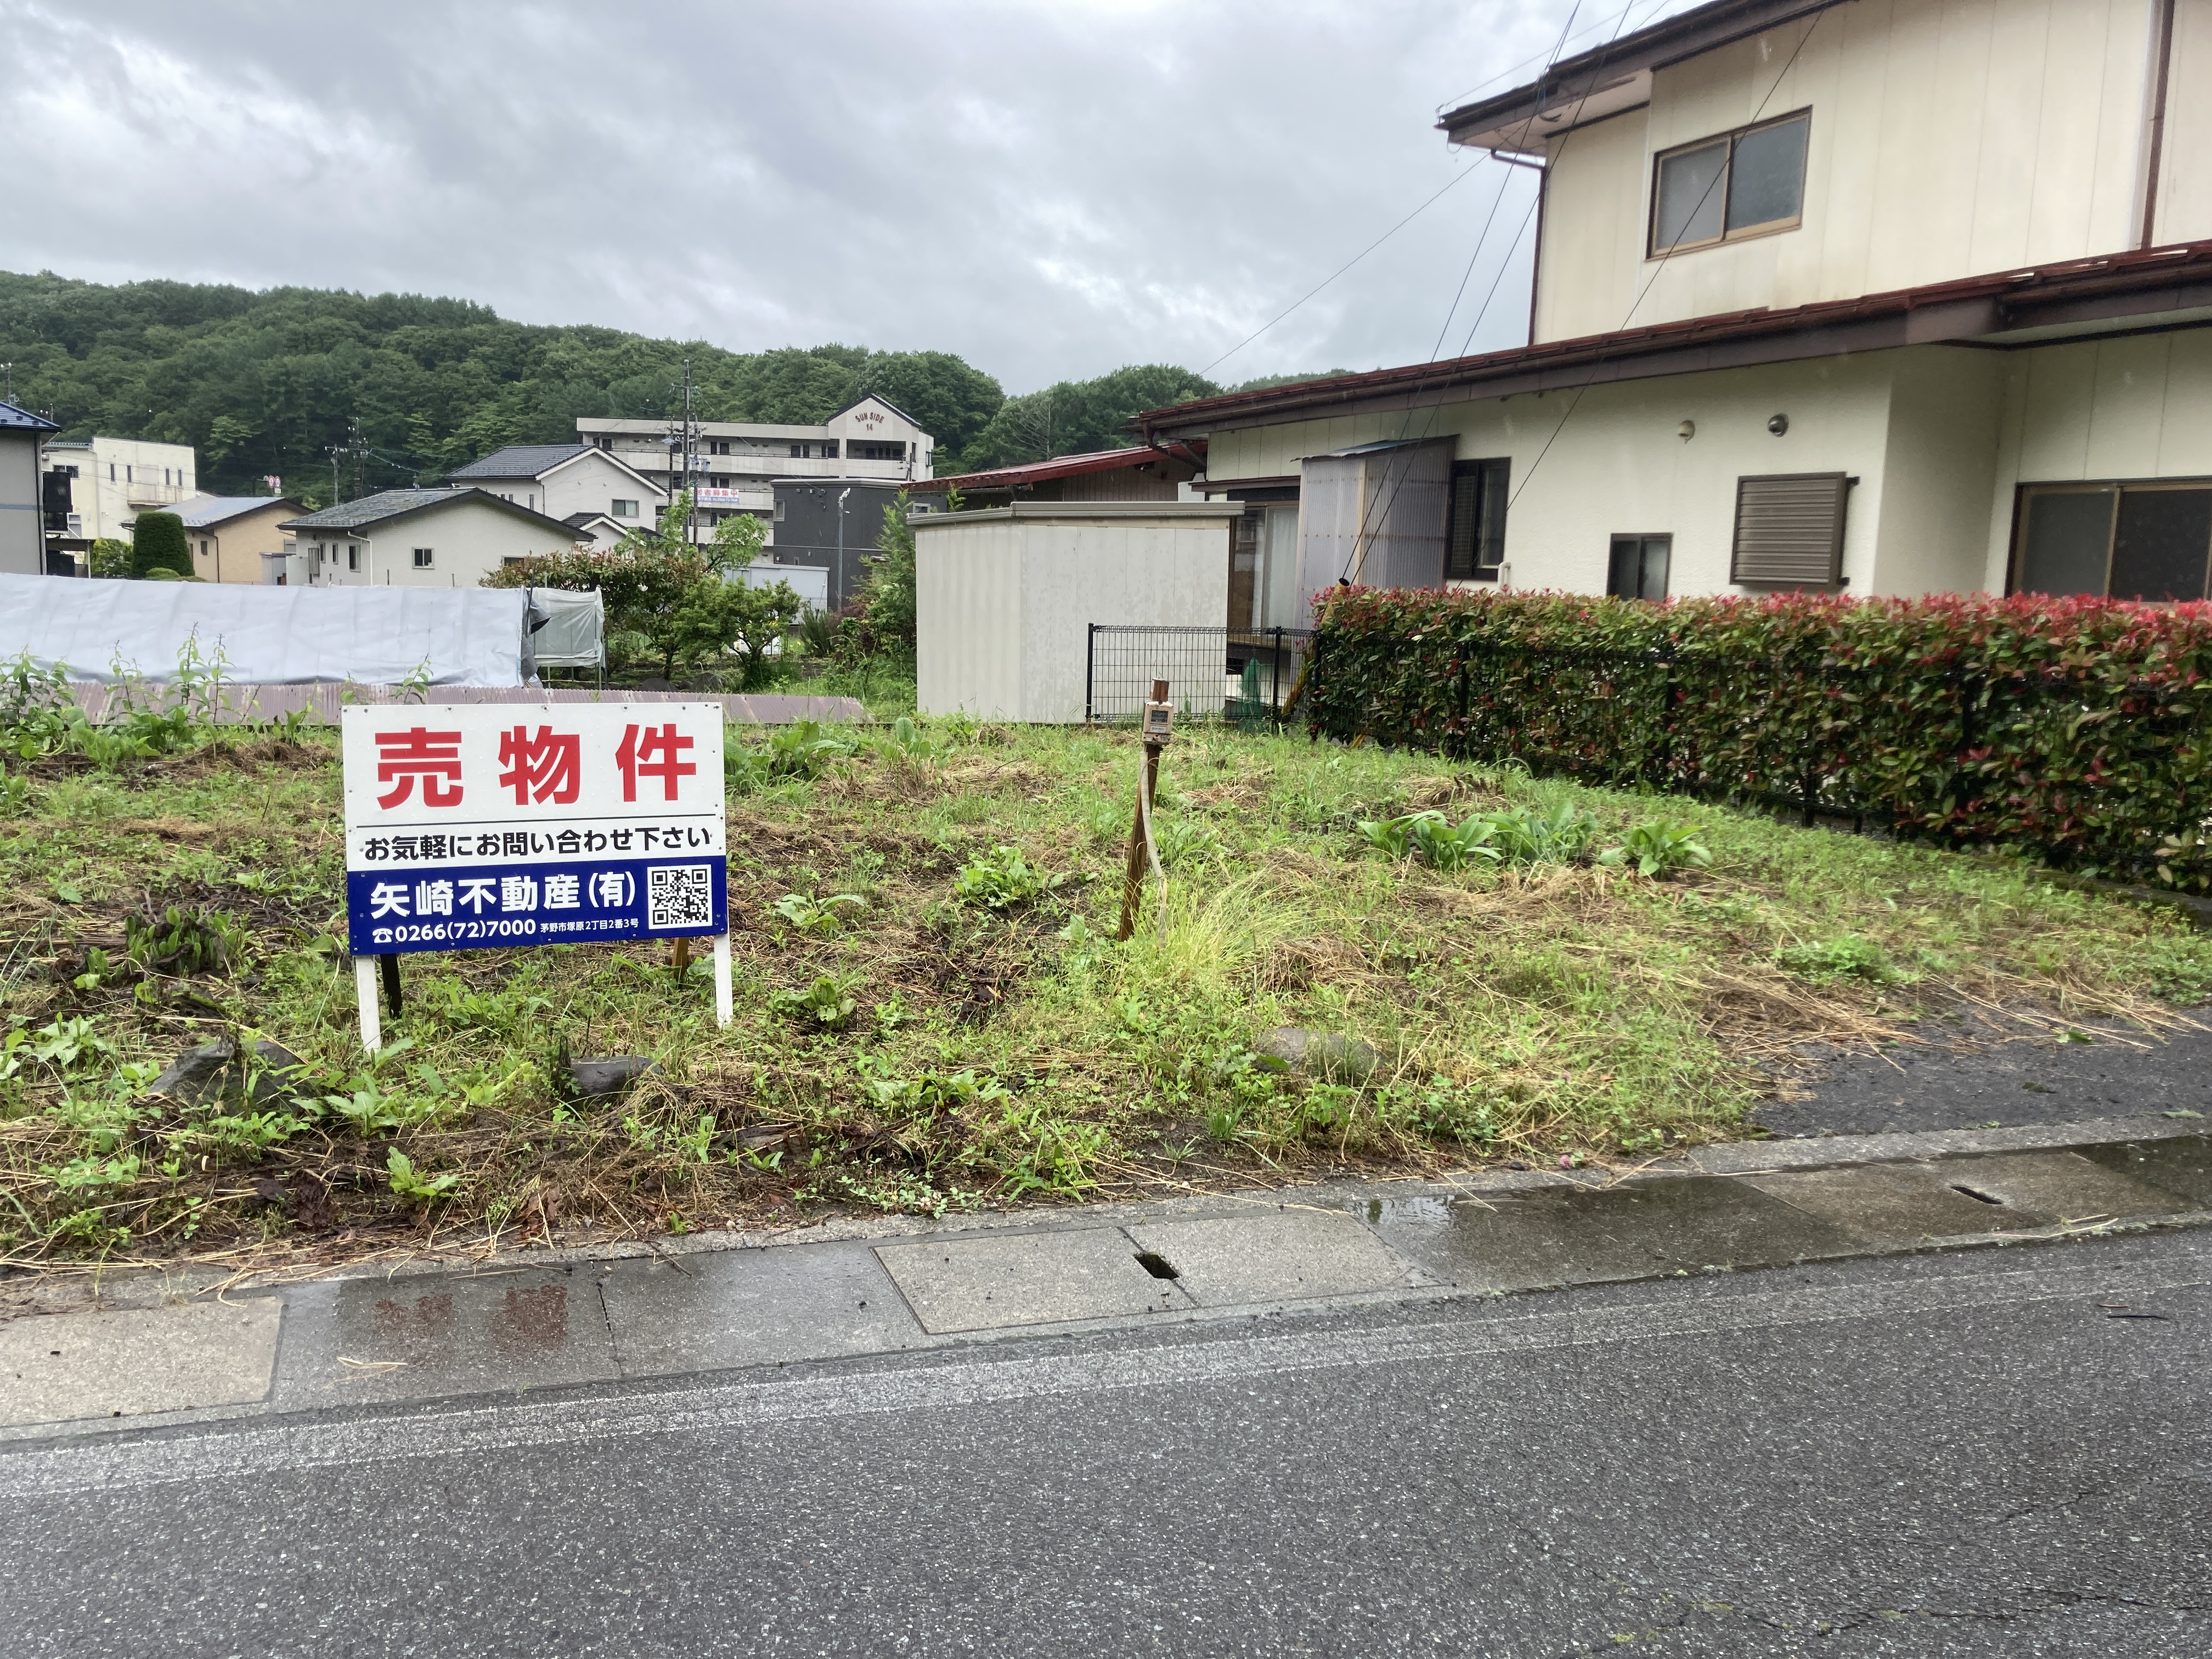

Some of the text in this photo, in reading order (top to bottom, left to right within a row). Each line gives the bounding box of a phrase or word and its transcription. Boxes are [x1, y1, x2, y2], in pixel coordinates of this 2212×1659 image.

[855, 412, 885, 424] SUN SIDE
[375, 724, 696, 810] 売物件
[364, 827, 710, 862] お気軽にお問い合わせ下さい
[395, 918, 639, 942] 0266(72)7000 茅野市塚原2丁目2番3号
